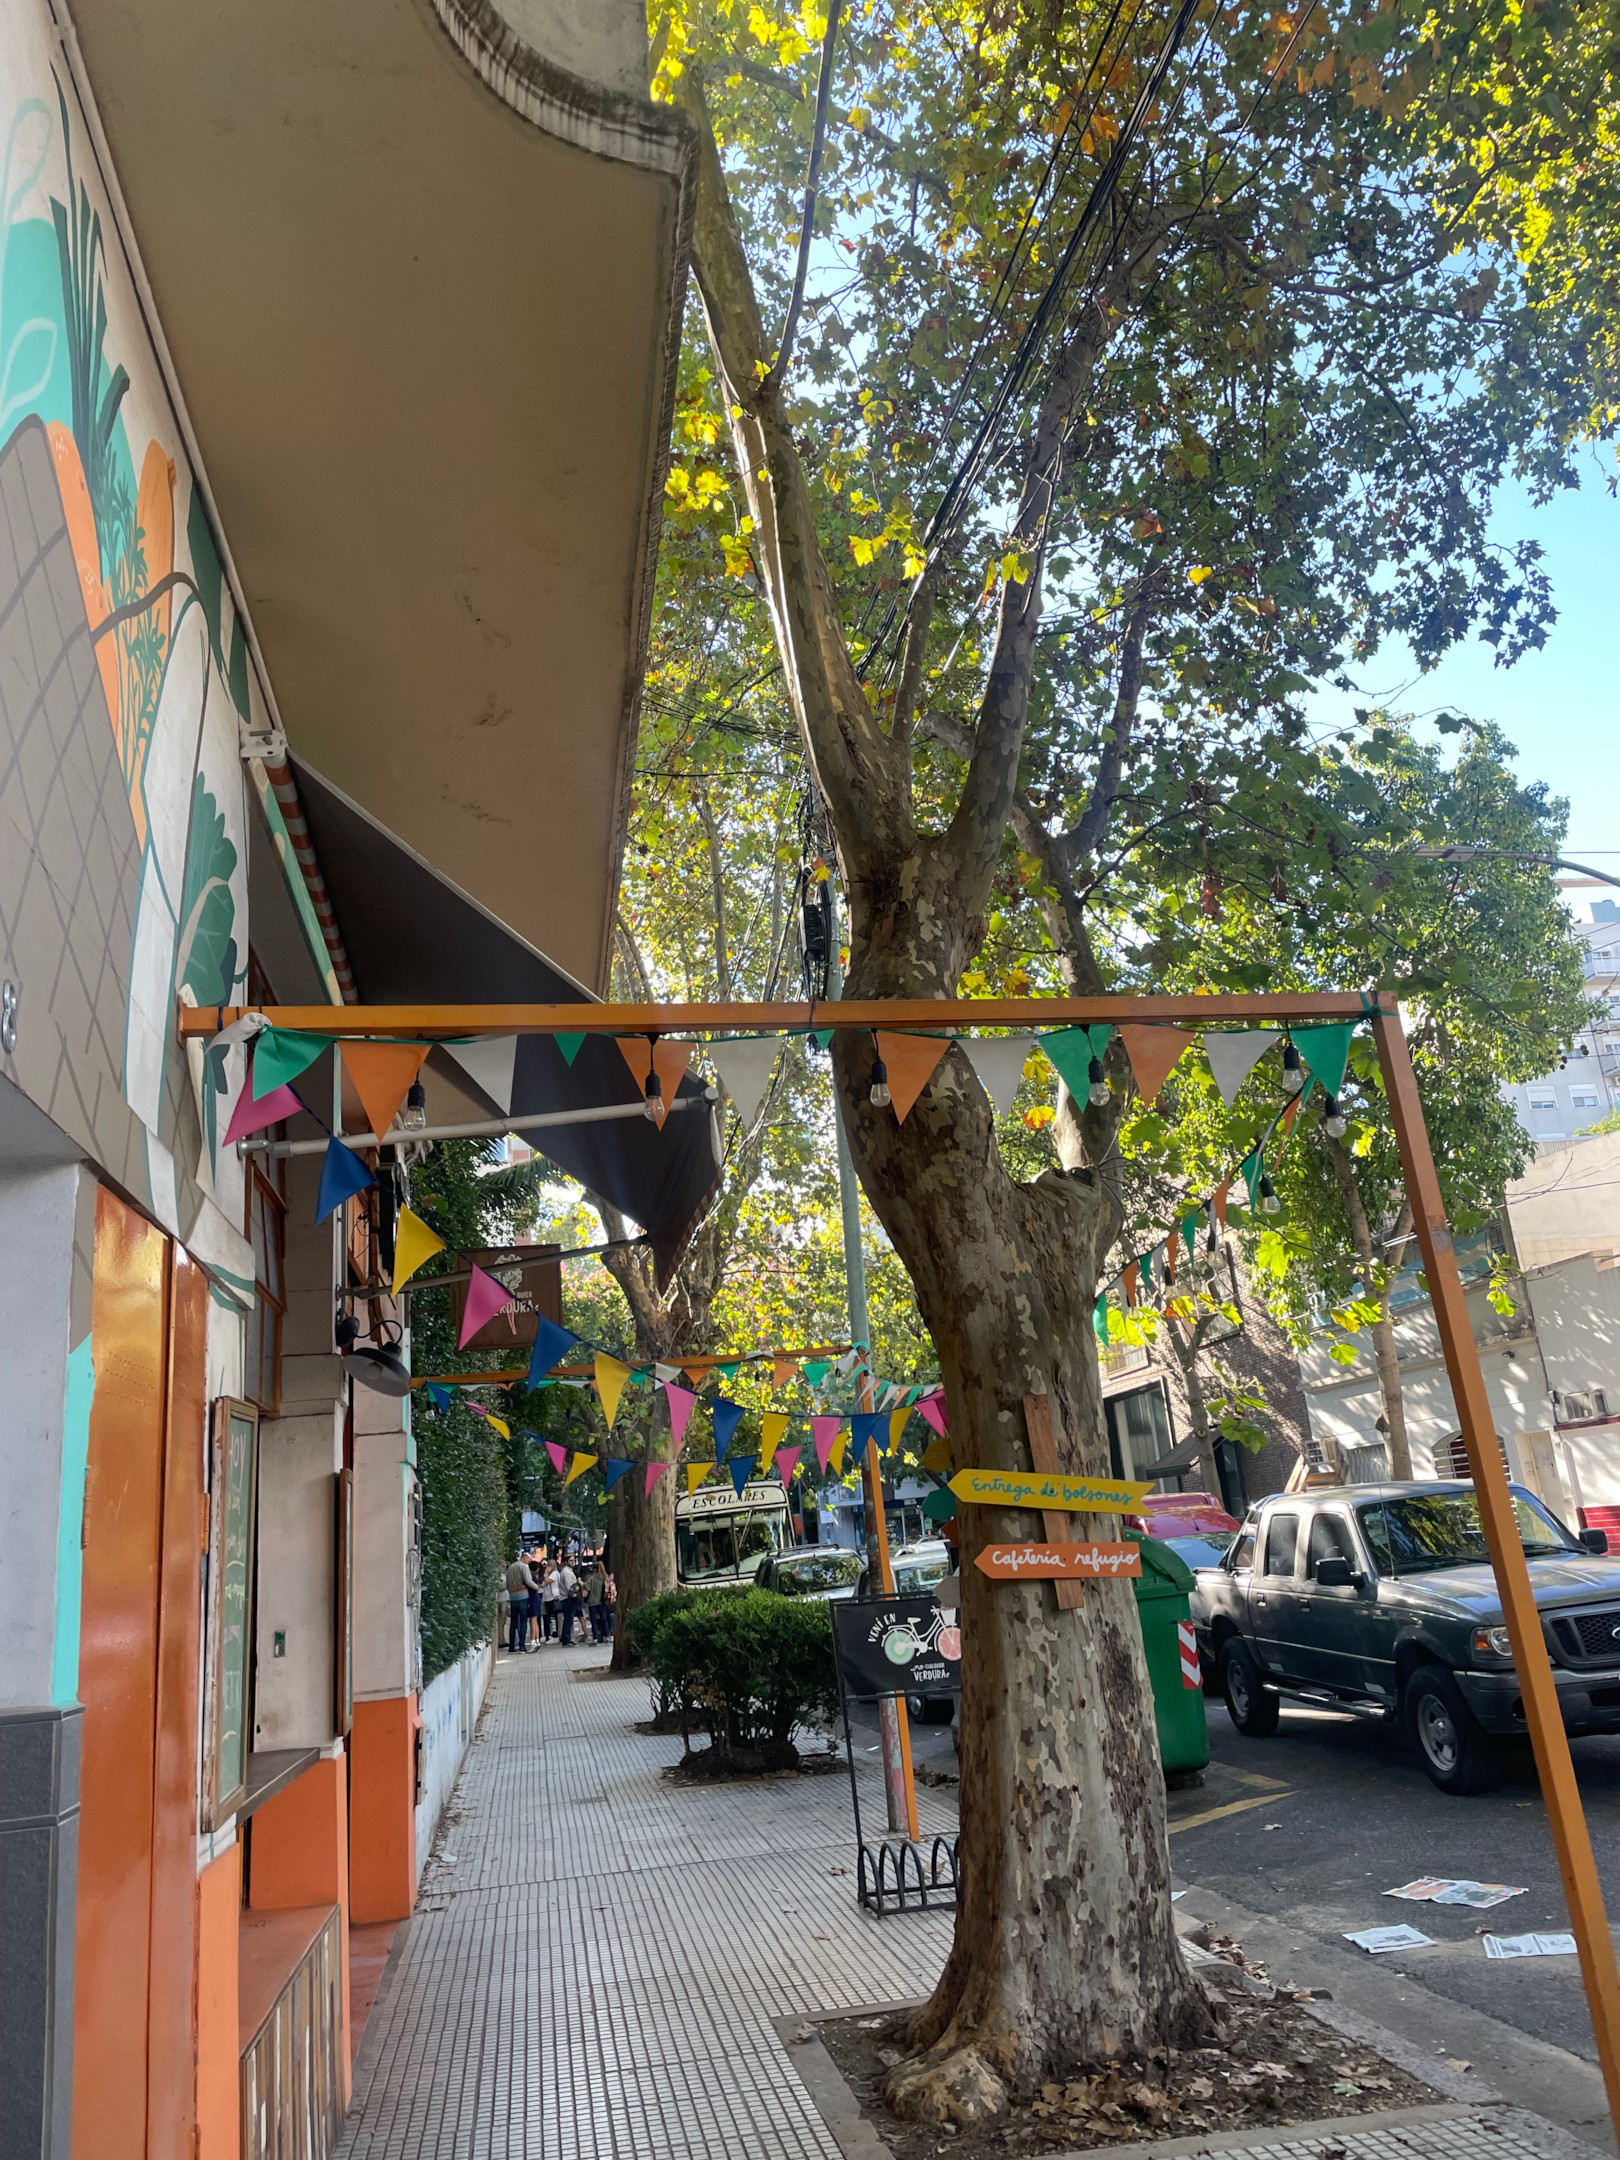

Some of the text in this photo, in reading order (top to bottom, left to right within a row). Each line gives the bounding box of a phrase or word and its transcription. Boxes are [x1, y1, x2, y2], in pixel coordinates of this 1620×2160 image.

[971, 1477, 1134, 1506] Entrega de bolsones
[1074, 1547, 1139, 1573] refugio
[883, 1612, 897, 1626] EN
